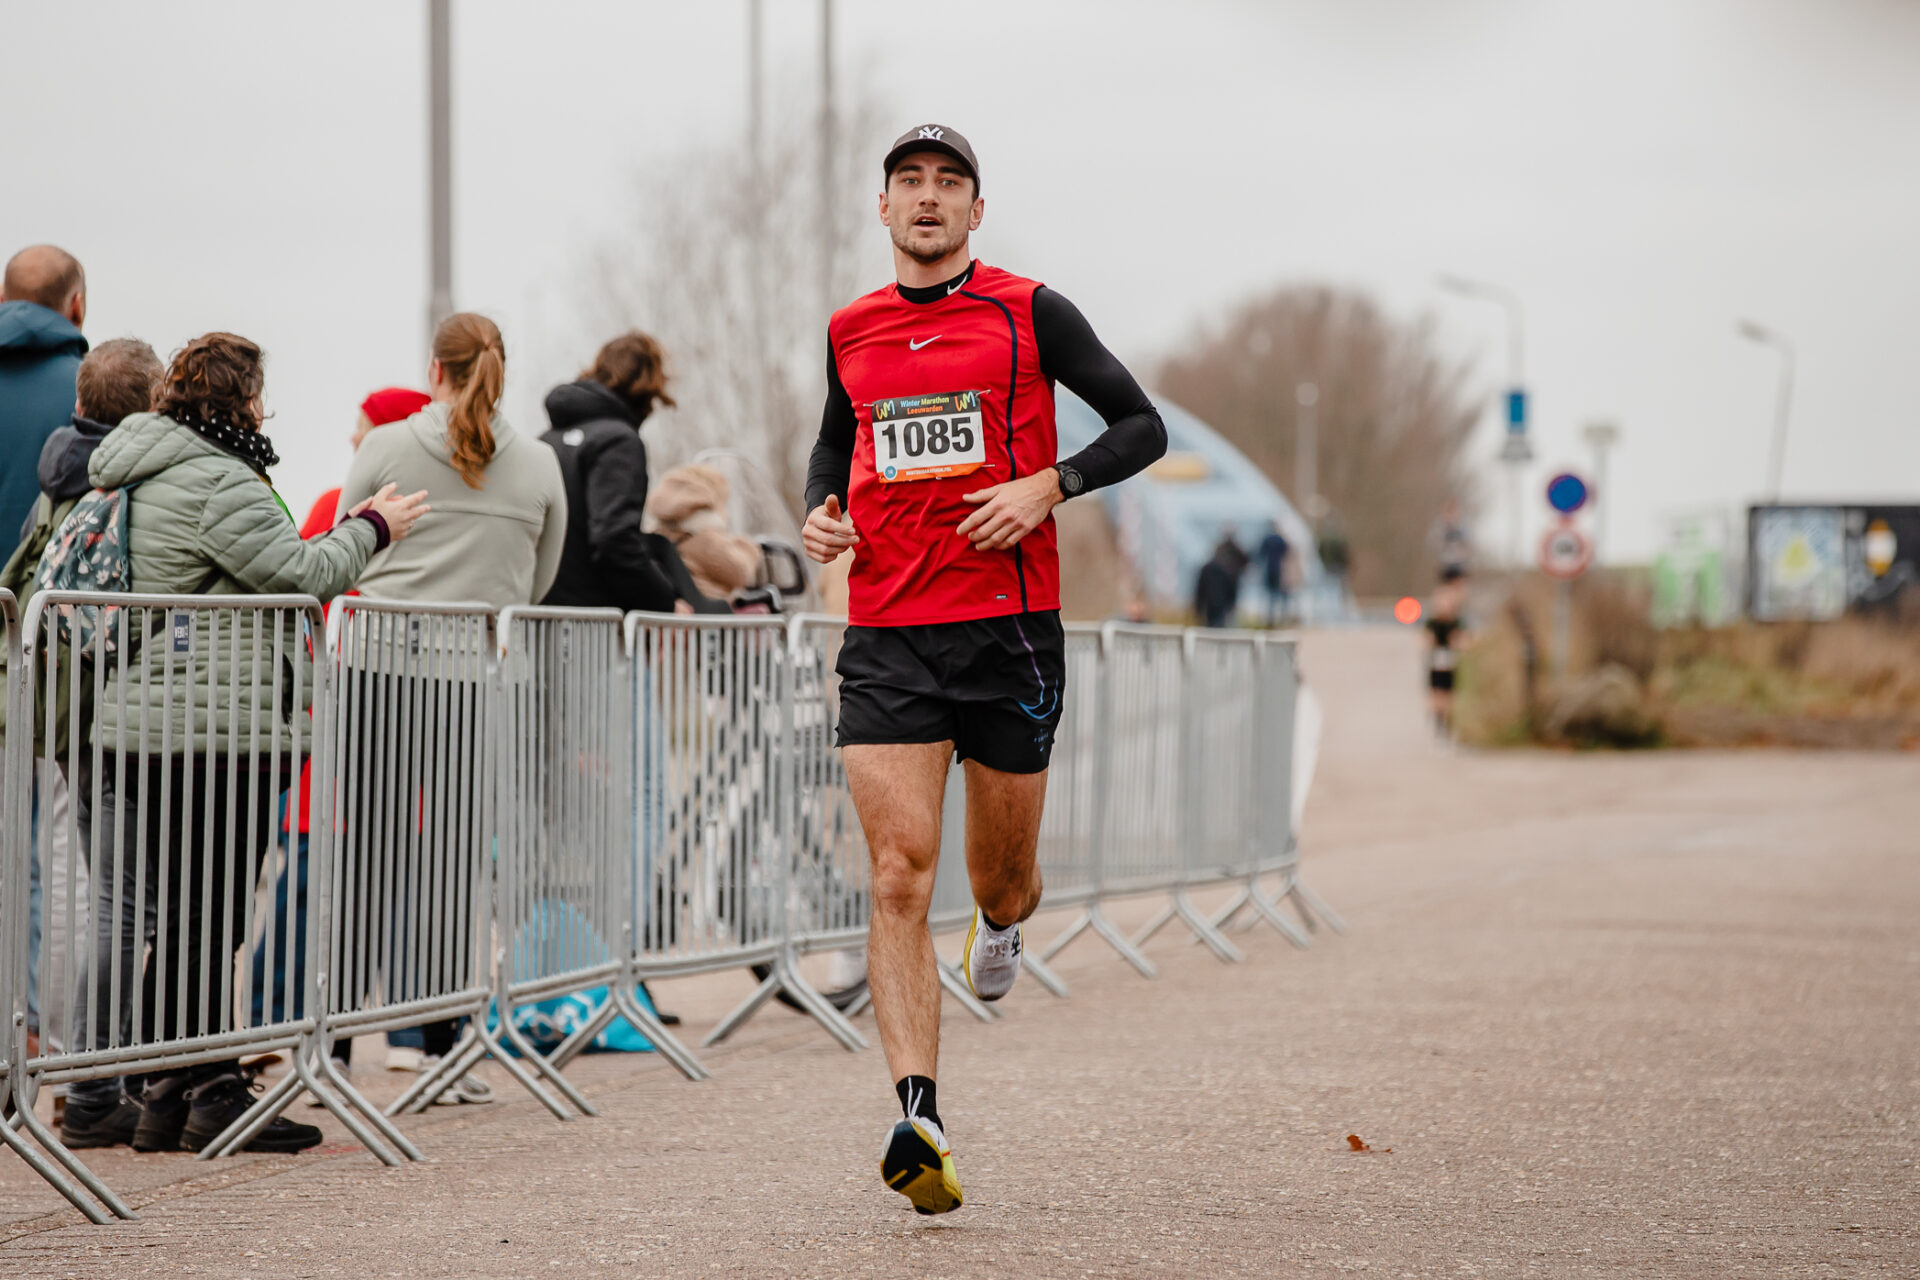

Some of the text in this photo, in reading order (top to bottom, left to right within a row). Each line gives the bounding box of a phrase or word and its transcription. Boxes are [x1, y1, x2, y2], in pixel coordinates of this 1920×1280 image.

[900, 396, 949, 408] Winter Marathon
[907, 405, 943, 415] Leeuwarden
[882, 417, 974, 459] 1085
